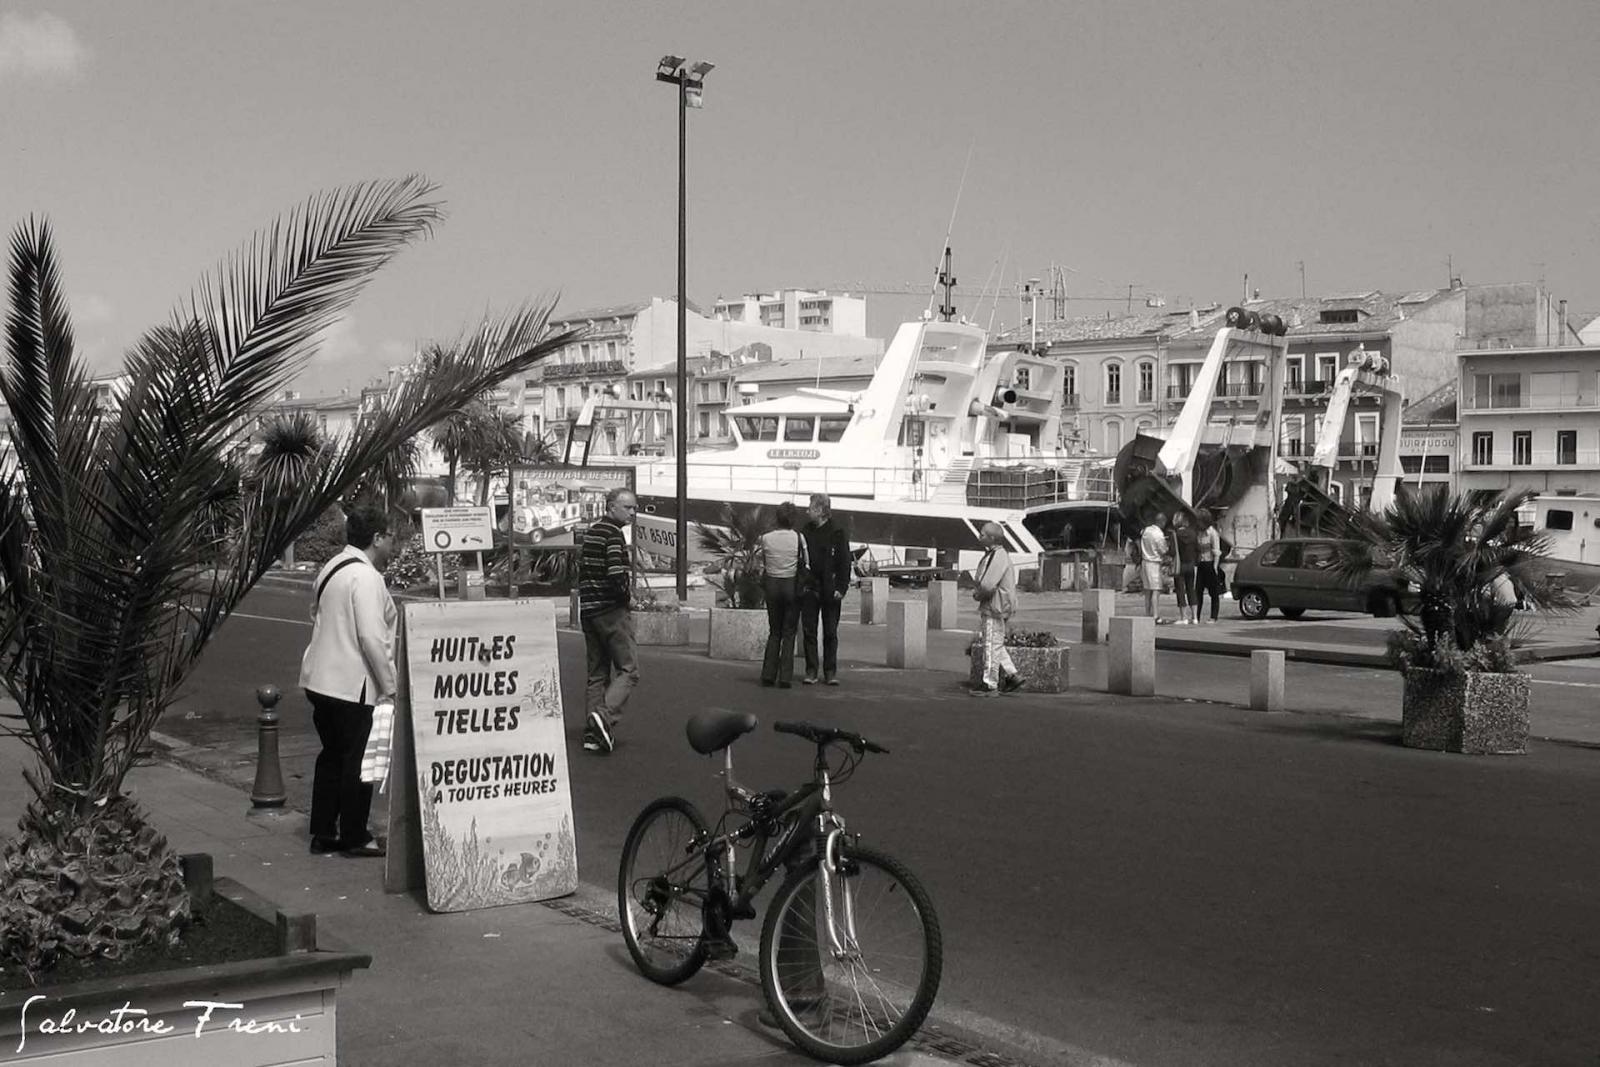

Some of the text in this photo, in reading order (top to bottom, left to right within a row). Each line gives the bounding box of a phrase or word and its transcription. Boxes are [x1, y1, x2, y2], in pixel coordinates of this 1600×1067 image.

[434, 670, 518, 699] MOULES
[435, 705, 520, 736] TIELLES
[431, 753, 555, 786] DEGUSTATION
[433, 779, 557, 804] A TOUTES HEURES
